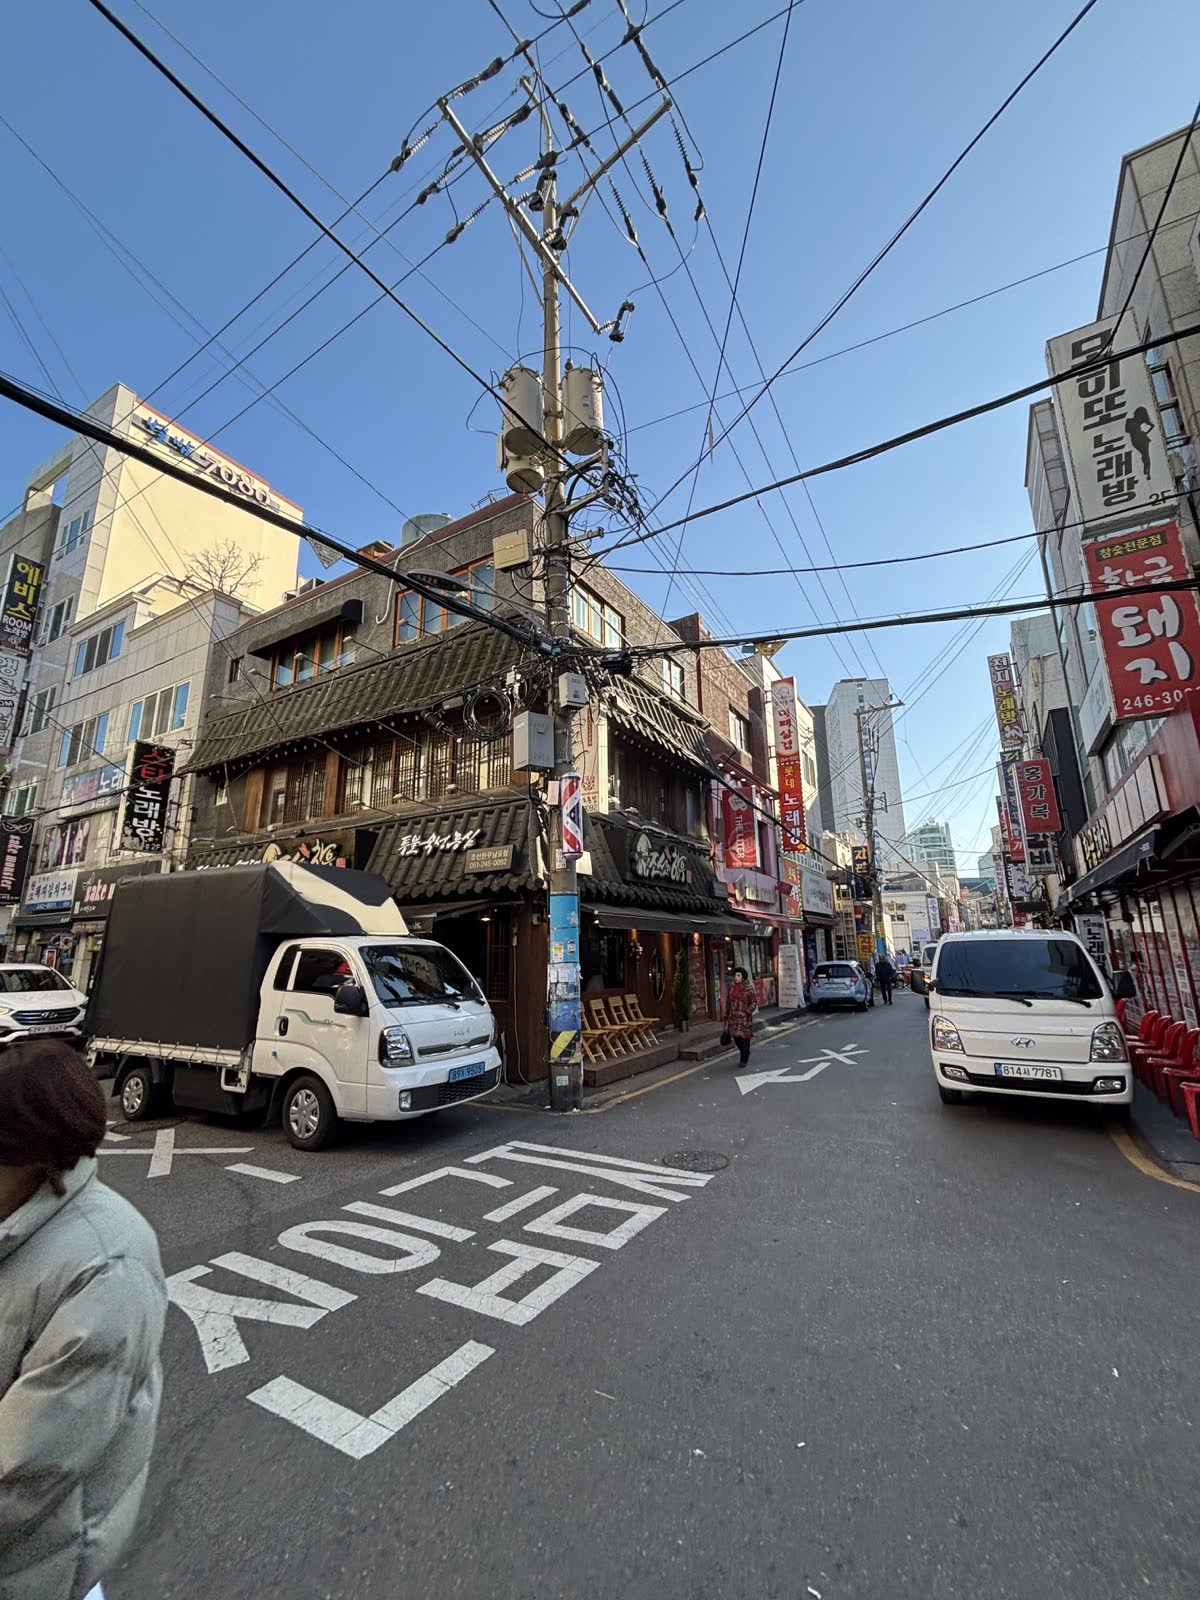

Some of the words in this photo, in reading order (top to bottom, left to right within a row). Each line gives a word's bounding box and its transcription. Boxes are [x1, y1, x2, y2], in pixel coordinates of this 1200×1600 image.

[1071, 328, 1128, 431] 모히또
[203, 452, 271, 507] 7080
[1092, 433, 1139, 507] 노래방
[1149, 490, 1171, 507] 2F
[1100, 533, 1163, 559] 참숯전문점
[6, 562, 40, 621] 에비스
[2, 614, 32, 632] ROOM
[1112, 595, 1191, 685] 돼지
[996, 686, 1017, 725] 노래방
[1122, 687, 1200, 711] 246-30
[132, 786, 163, 837] 노래방
[1024, 765, 1051, 819] 홍가복
[783, 792, 803, 845] 노래방
[1032, 1067, 1057, 1078] 7781
